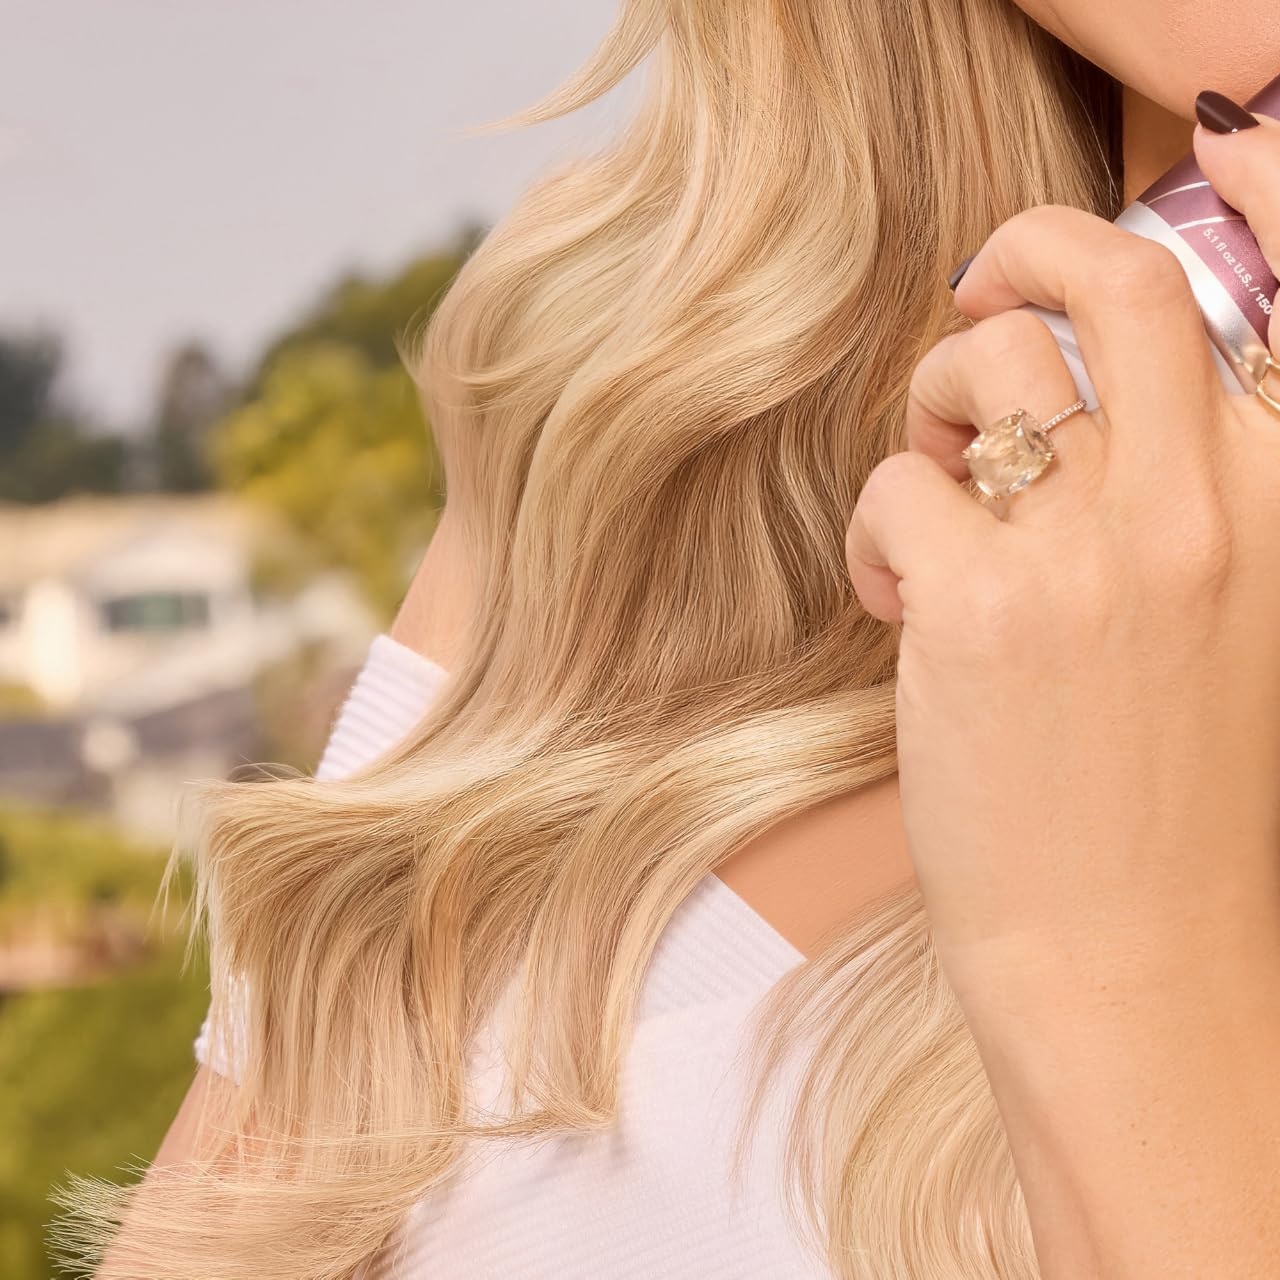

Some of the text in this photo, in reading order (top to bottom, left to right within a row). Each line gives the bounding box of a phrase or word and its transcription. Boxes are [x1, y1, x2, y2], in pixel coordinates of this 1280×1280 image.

[1203, 227, 1219, 243] 5.1
[1215, 242, 1228, 252] fl
[1222, 251, 1236, 266] oz
[1233, 263, 1253, 287] U.S.
